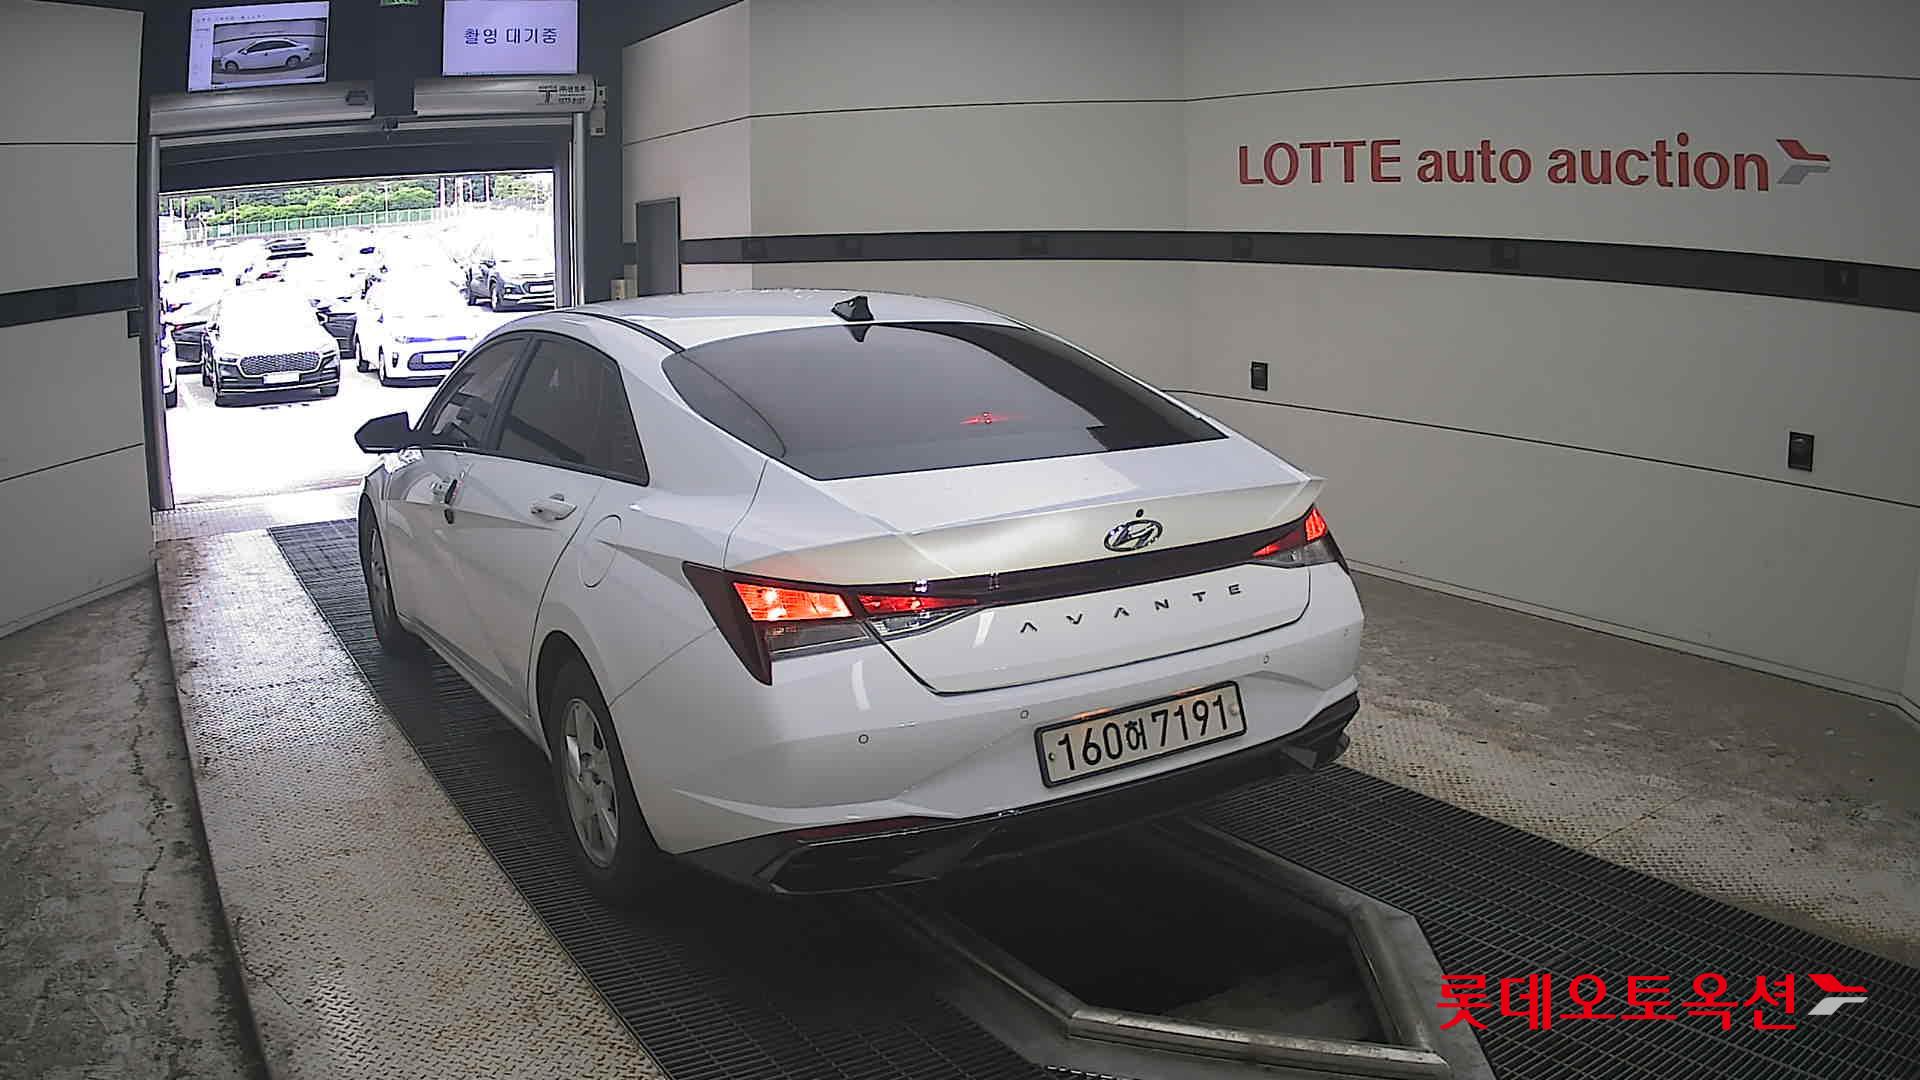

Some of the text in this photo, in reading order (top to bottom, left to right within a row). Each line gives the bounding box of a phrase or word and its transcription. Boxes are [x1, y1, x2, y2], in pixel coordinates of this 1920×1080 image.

[464, 27, 558, 45] 촬영 대기중
[1239, 132, 1769, 191] LOTTE auto auction
[1020, 584, 1241, 633] AVANTE
